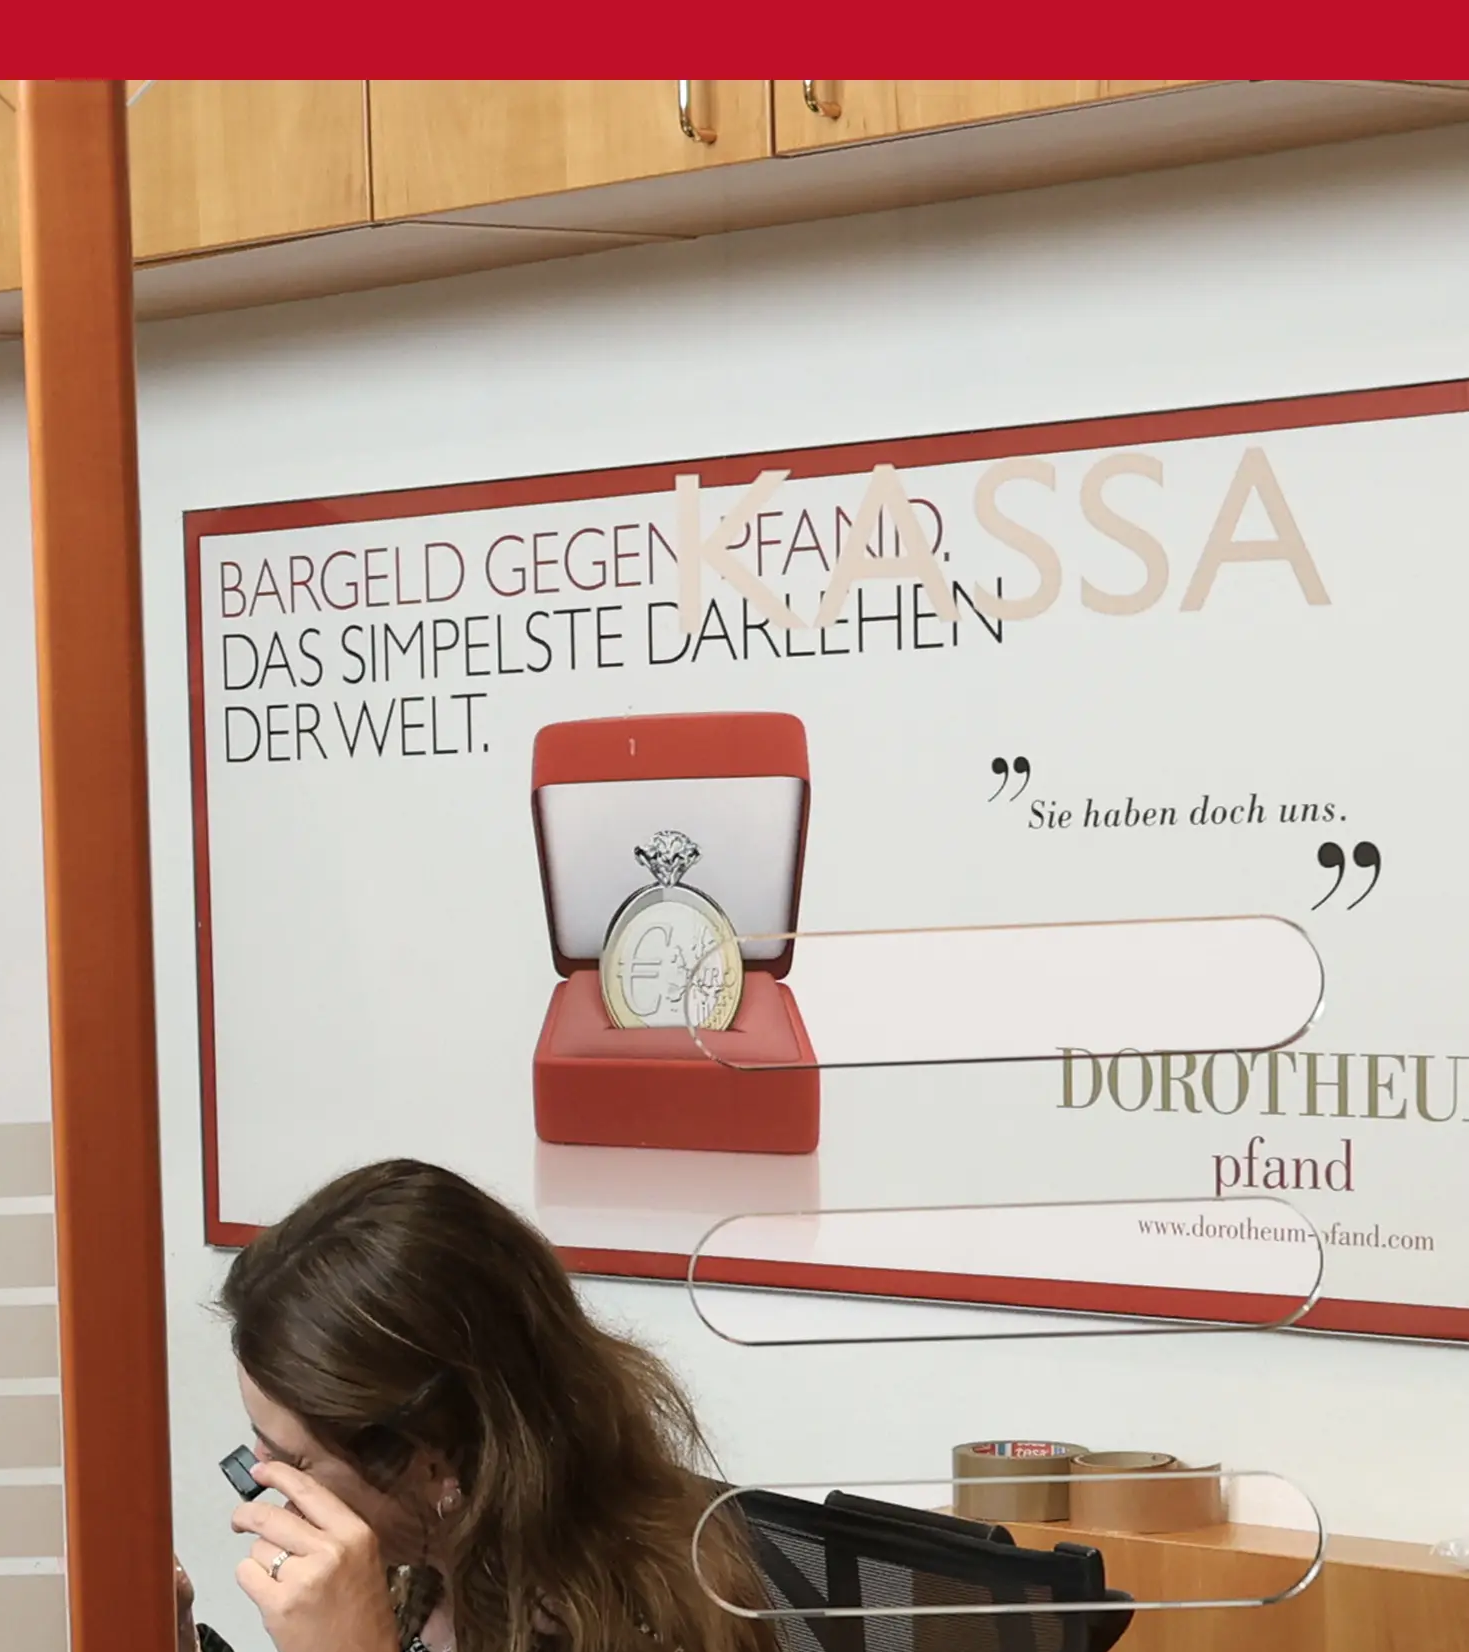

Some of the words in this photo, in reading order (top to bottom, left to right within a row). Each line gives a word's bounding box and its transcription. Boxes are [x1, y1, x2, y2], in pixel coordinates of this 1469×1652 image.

[674, 446, 1331, 634] KASSA
[219, 541, 465, 619] BARGELD
[222, 627, 324, 692] DAS
[341, 606, 625, 685] SIMPELSTE
[224, 702, 328, 763] DER
[333, 692, 490, 758] WELT.
[1028, 799, 1072, 830] Sie
[1082, 796, 1178, 829] haben
[1189, 793, 1267, 827] doch
[1279, 801, 1348, 824] uns.
[1212, 1136, 1355, 1197] pfand
